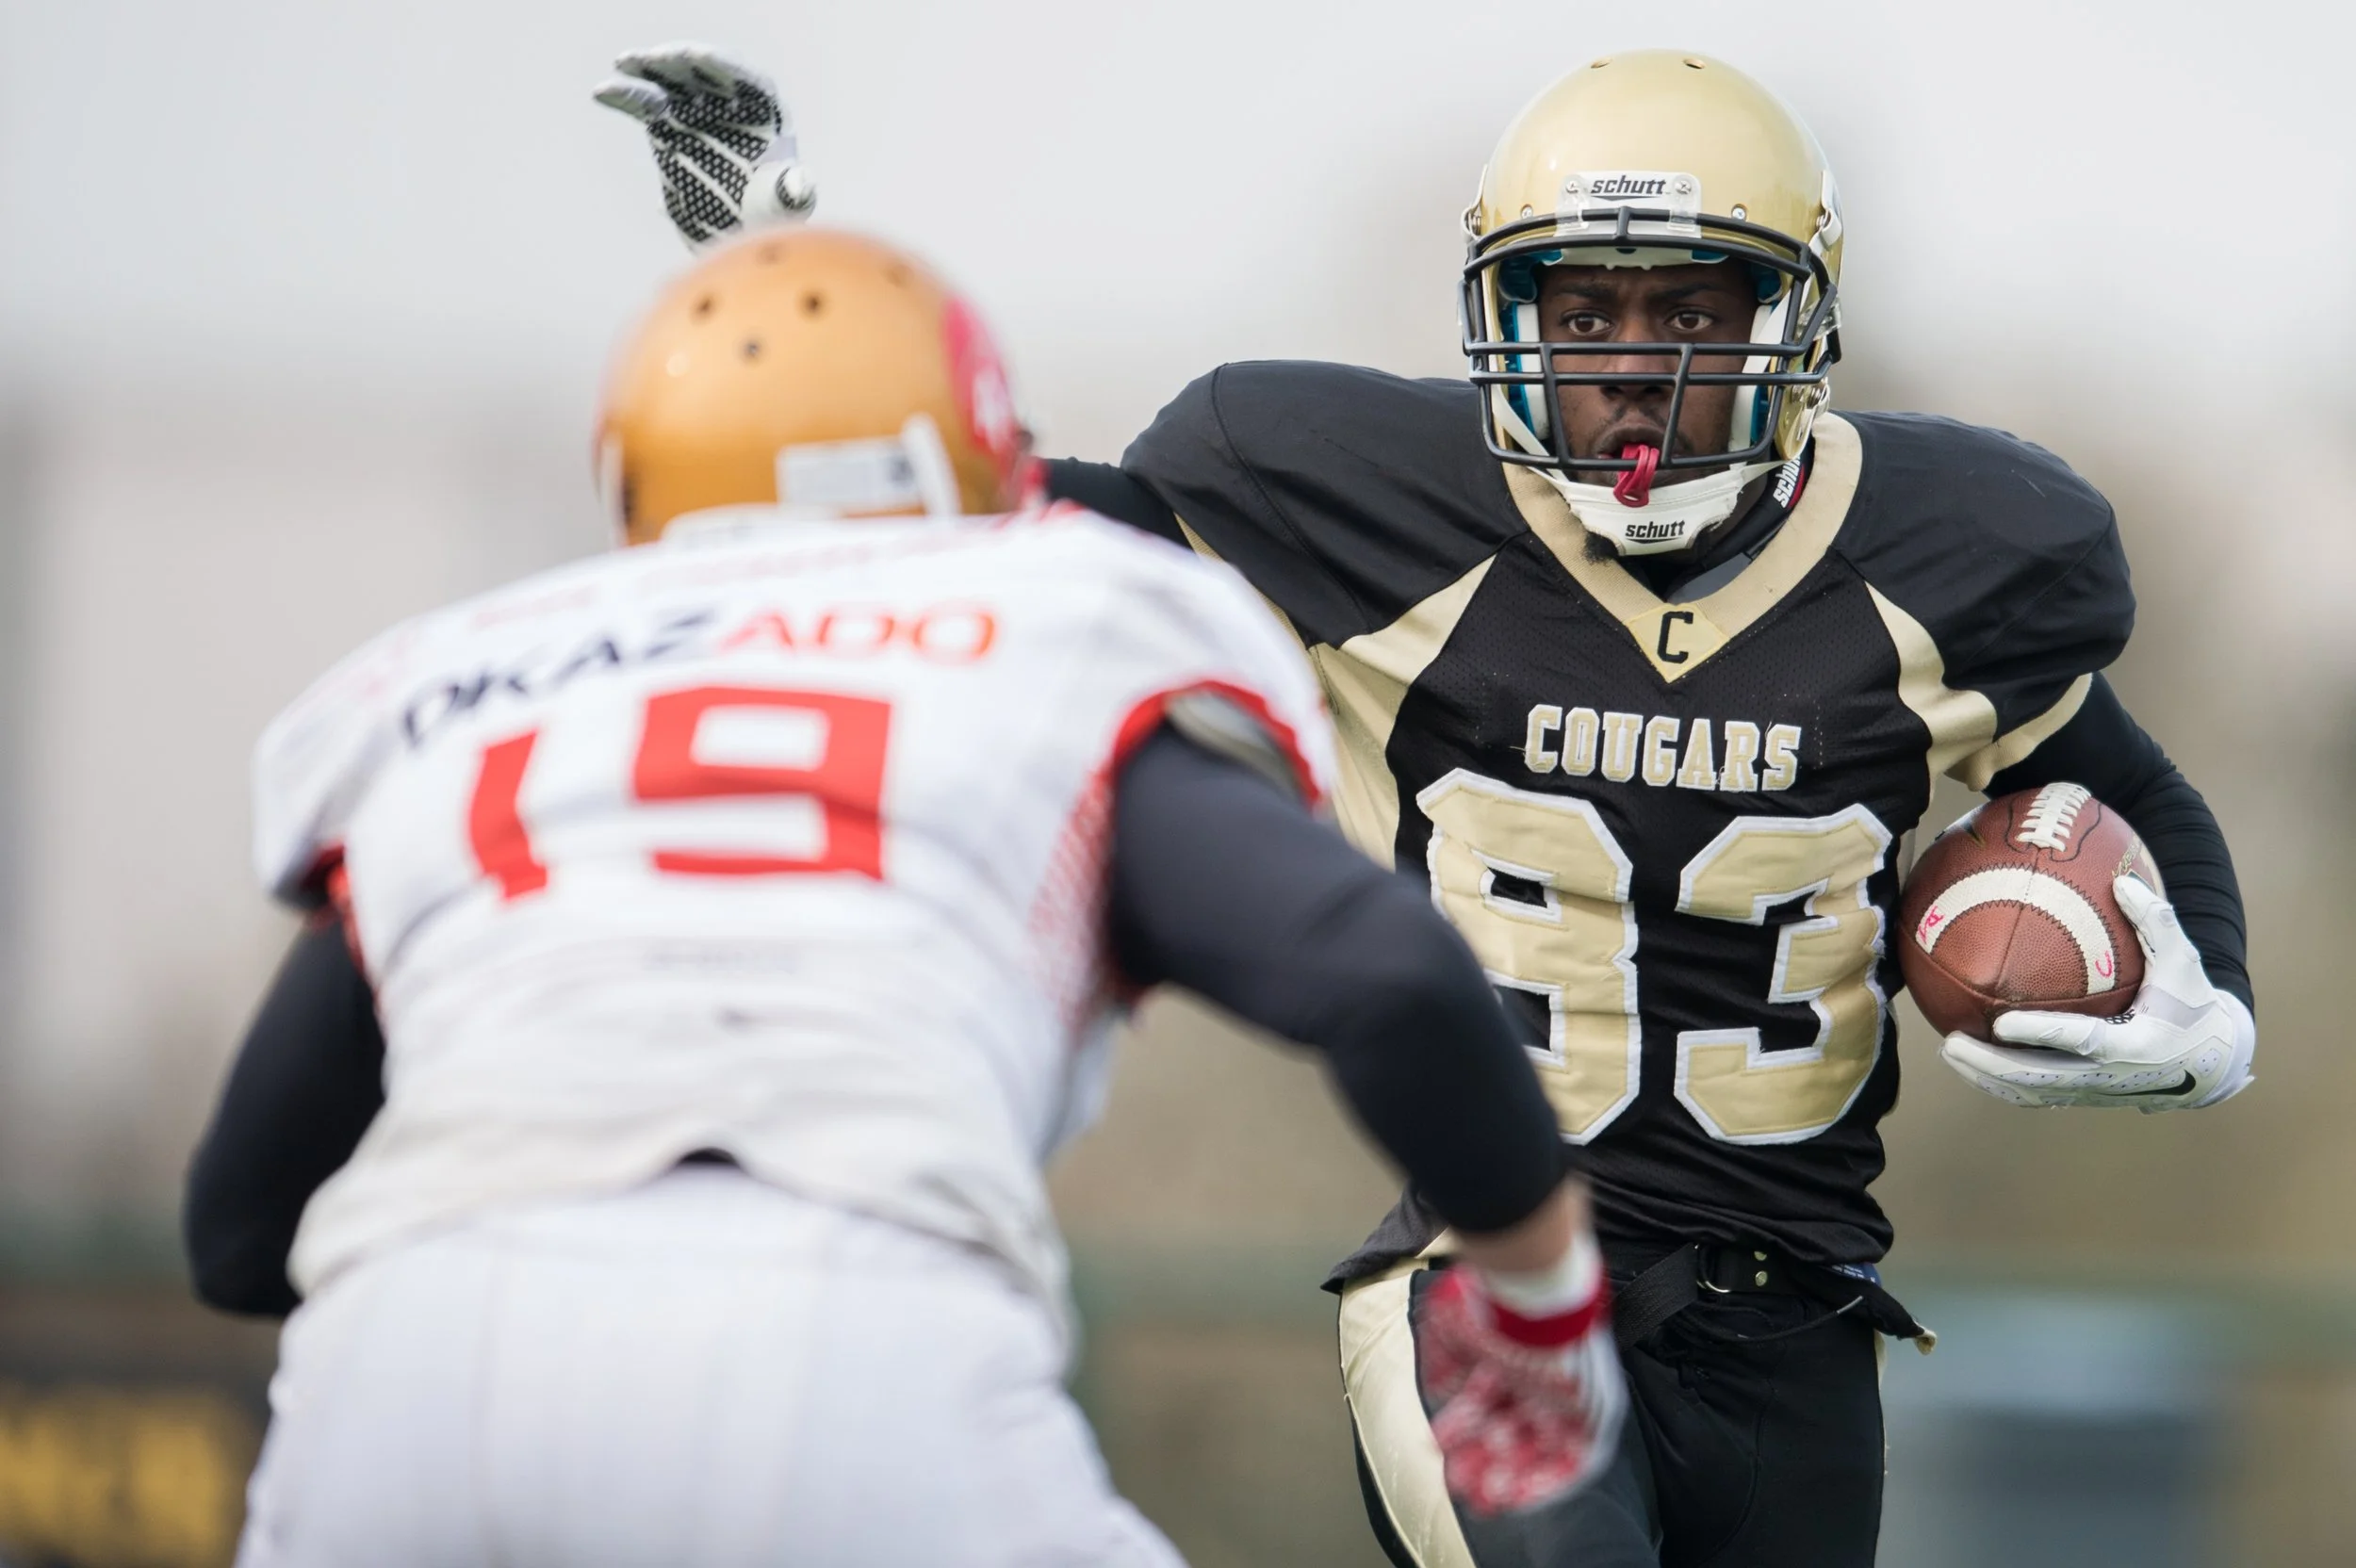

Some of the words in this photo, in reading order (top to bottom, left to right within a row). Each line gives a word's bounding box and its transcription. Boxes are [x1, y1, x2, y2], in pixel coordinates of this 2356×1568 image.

[1591, 174, 1667, 195] schutt
[1773, 455, 1801, 508] schu
[1625, 520, 1685, 538] schutt
[1657, 611, 1693, 663] C
[1524, 704, 1801, 792] COUGARS
[466, 685, 893, 905] 19
